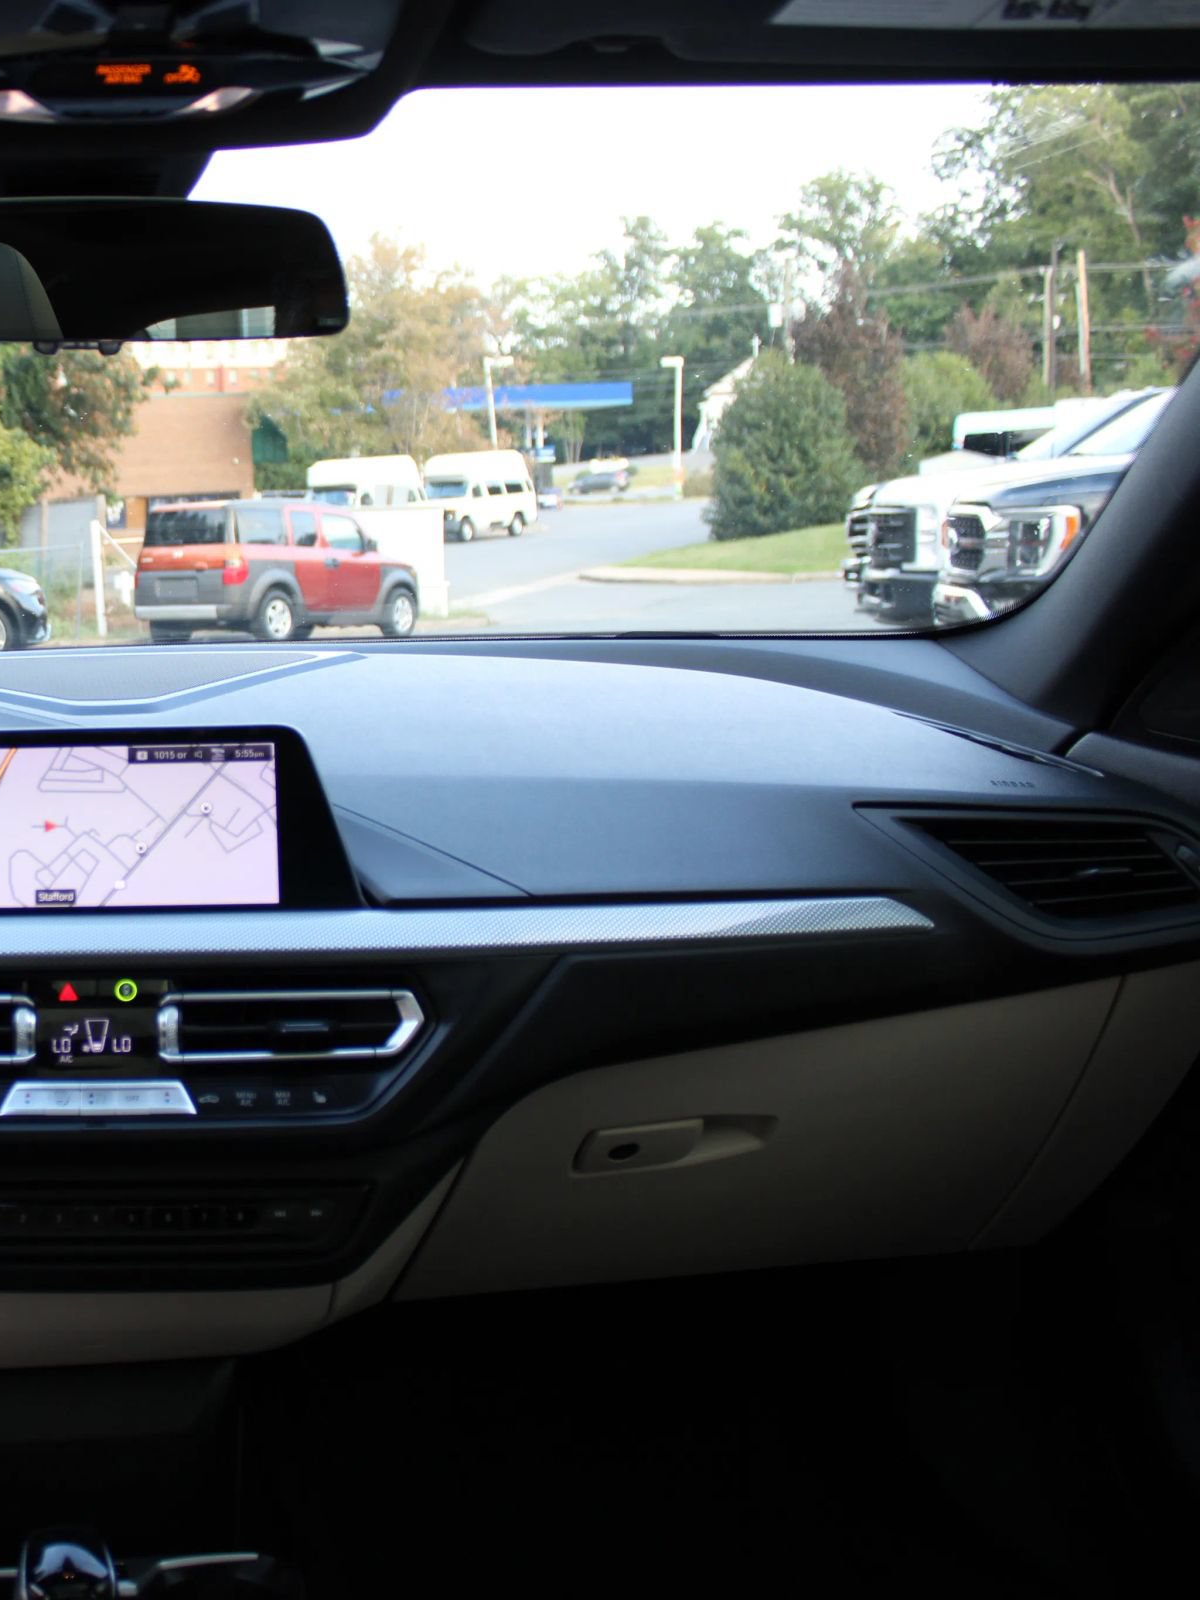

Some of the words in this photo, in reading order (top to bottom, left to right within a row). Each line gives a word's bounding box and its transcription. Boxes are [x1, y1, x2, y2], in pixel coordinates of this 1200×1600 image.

[154, 751, 176, 760] 1015
[38, 891, 74, 902] Stafford
[52, 1037, 72, 1054] LO
[112, 1036, 132, 1053] LO
